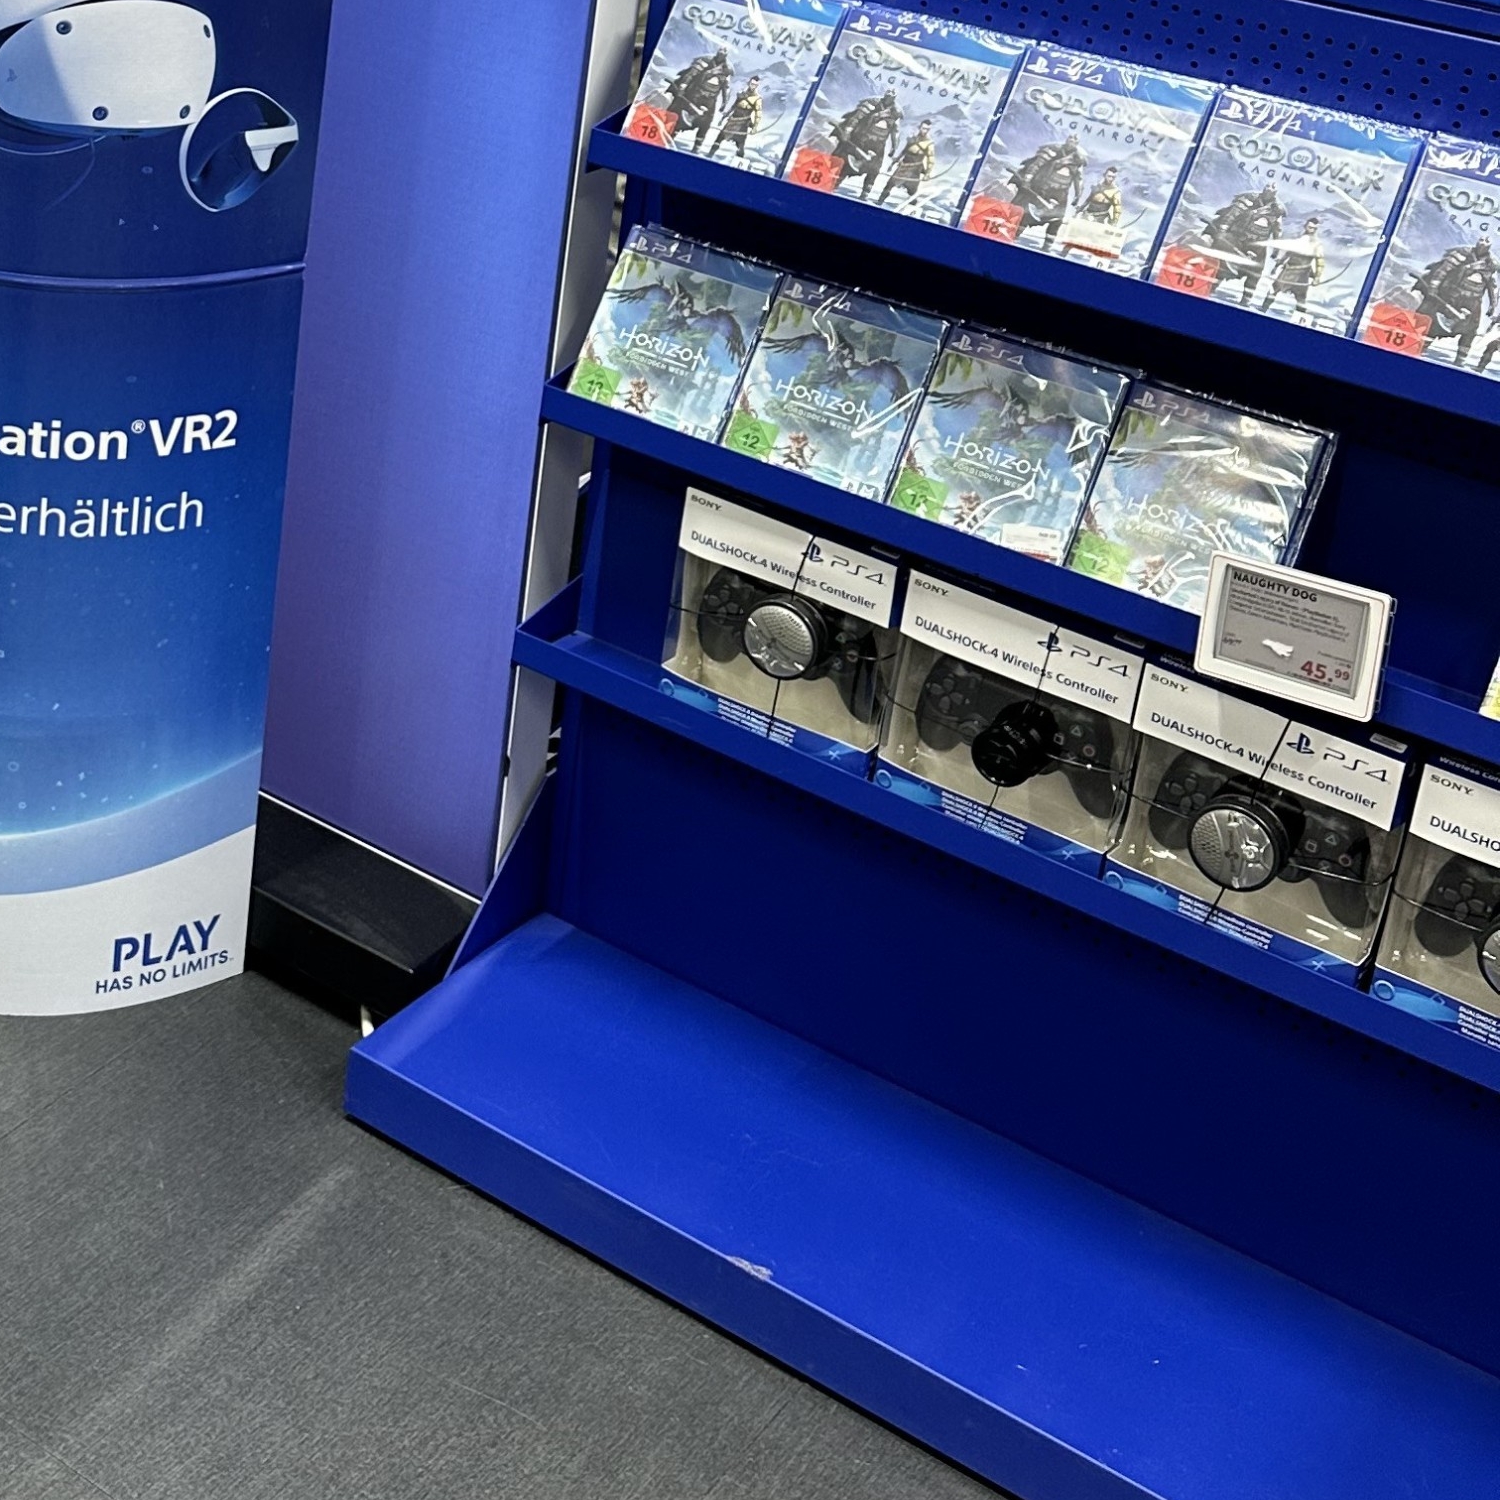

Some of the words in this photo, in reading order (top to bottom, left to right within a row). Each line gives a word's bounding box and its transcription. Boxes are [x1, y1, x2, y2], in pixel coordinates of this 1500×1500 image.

[683, 4, 736, 34] GOD
[874, 21, 922, 42] PS4
[640, 125, 658, 140] 18
[1217, 133, 1285, 164] GOD
[803, 169, 823, 186] 18
[1426, 183, 1498, 217] GOD
[981, 219, 1000, 234] 18
[619, 324, 710, 372] HORIZON
[976, 343, 1024, 366] PS4
[775, 376, 874, 426] HORIZON
[742, 433, 760, 450] 12
[944, 431, 1051, 481] HORIZON
[690, 494, 722, 512] SONY
[830, 554, 886, 585] PS4
[819, 581, 877, 610] Controller
[914, 577, 949, 596] SONY
[1233, 571, 1290, 596] NAUGHTY
[1291, 585, 1318, 603] DOG
[1070, 643, 1130, 678] PS4
[1056, 672, 1119, 705] Controller
[1150, 672, 1190, 693] SONY
[1322, 746, 1388, 783] PS4
[1439, 755, 1480, 776] Wireless
[1307, 774, 1378, 810] Controller
[1429, 773, 1475, 796] SONY
[112, 913, 221, 973] PLAY
[95, 975, 133, 994] HAS
[139, 968, 166, 987] NO
[172, 950, 229, 979] LIMITS
